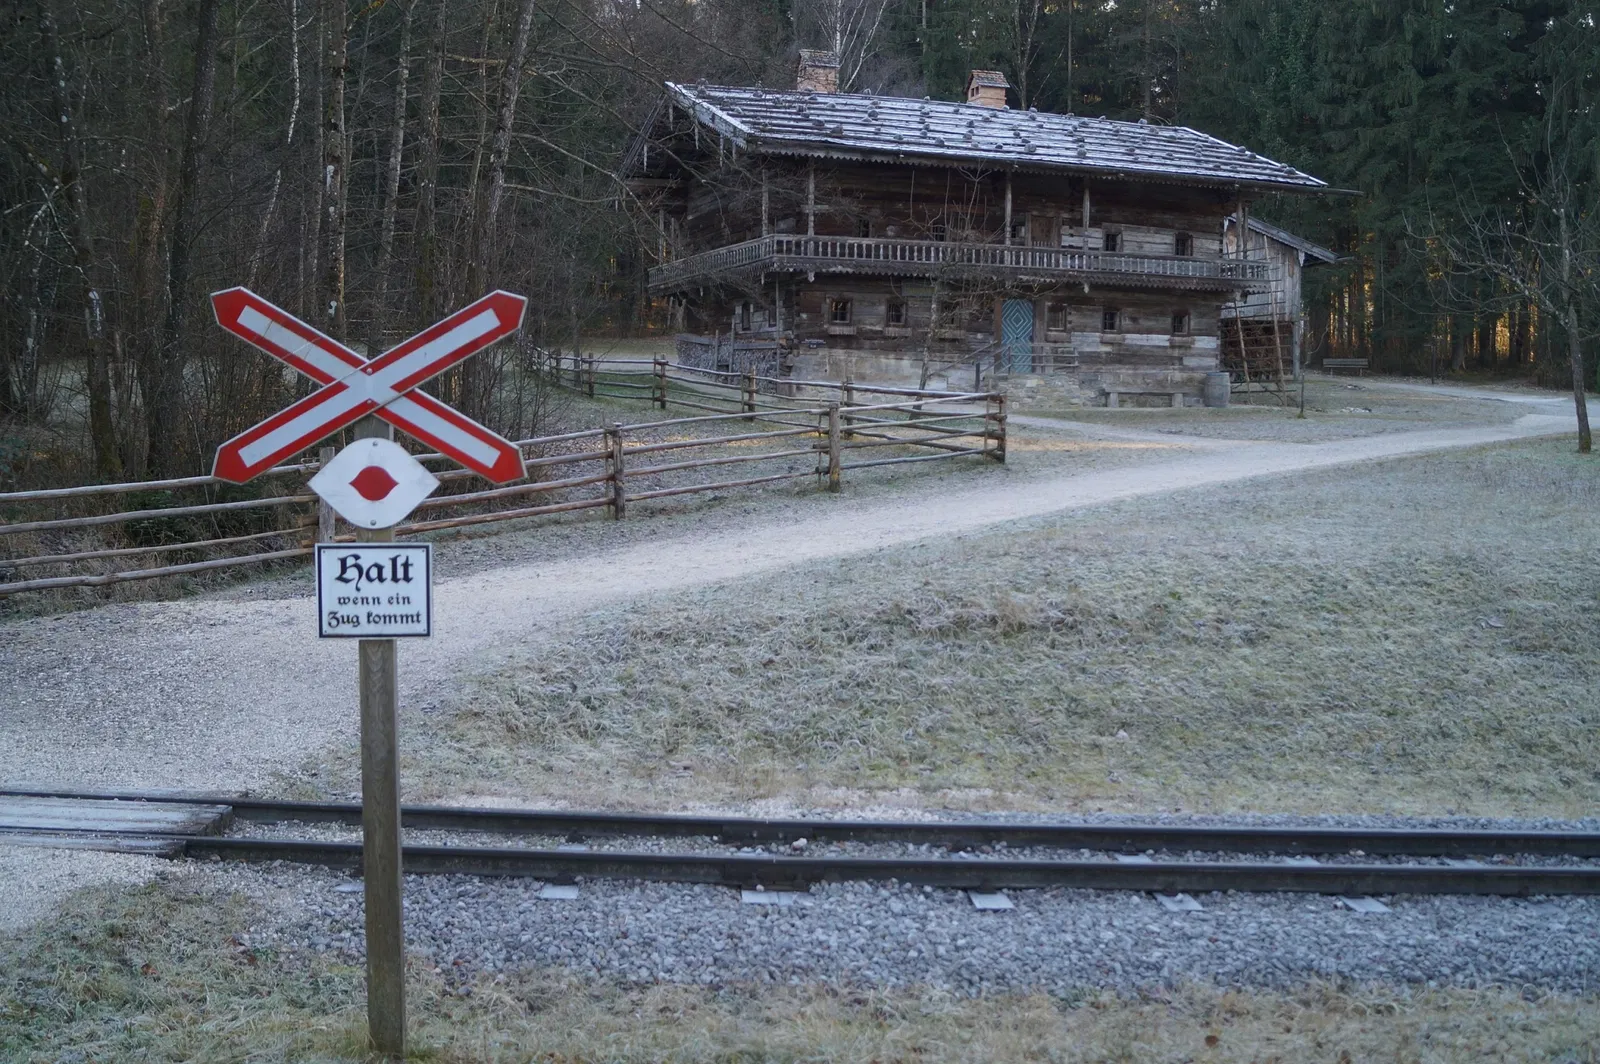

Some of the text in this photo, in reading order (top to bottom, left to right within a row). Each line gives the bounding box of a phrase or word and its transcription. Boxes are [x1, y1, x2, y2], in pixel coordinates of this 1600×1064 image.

[334, 553, 414, 592] Halt
[337, 592, 411, 605] wenn ein
[327, 610, 421, 628] Zug kommt
